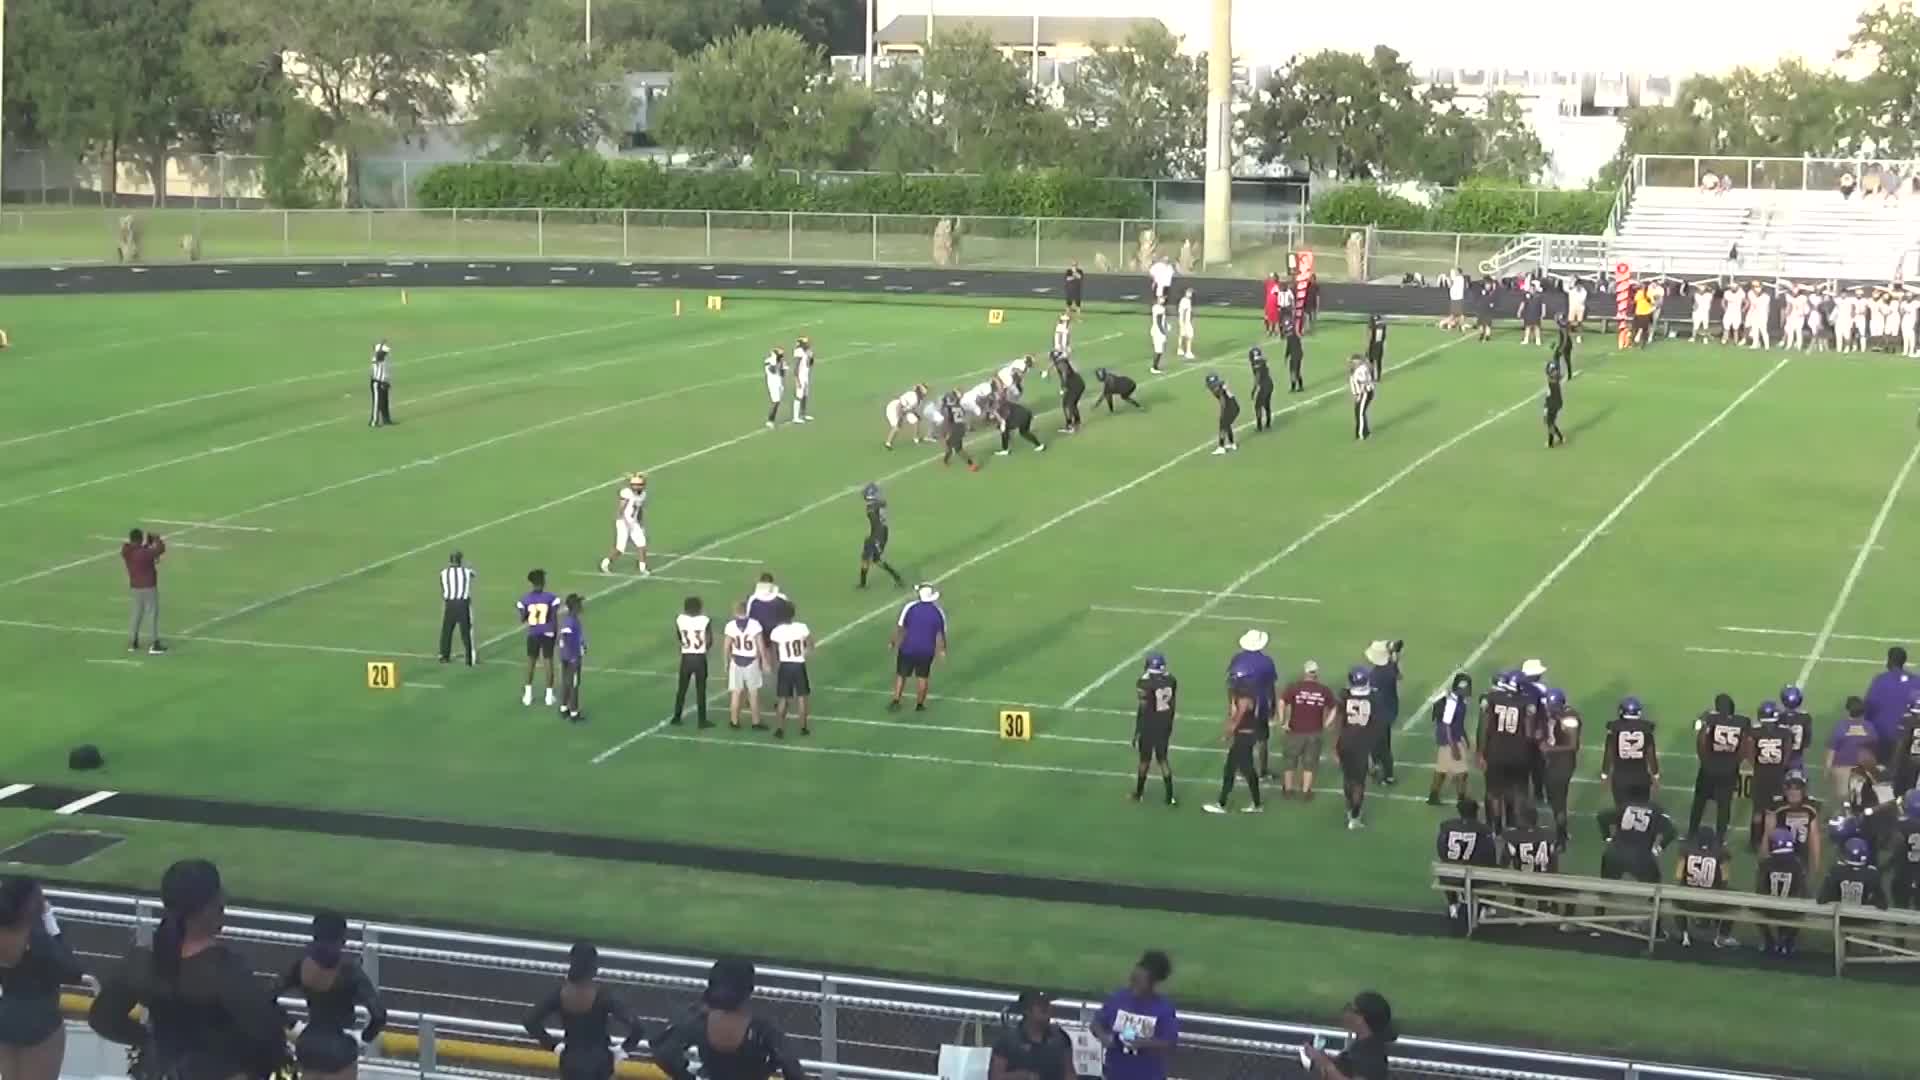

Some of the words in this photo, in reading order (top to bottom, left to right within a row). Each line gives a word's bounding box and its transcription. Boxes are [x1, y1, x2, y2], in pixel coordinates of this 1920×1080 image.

[372, 665, 389, 686] 20
[1005, 714, 1024, 738] 30
[1494, 704, 1519, 734] 70
[1618, 731, 1645, 760] 62
[1713, 724, 1742, 752] 55
[1757, 738, 1782, 764] 35
[1447, 831, 1476, 860] 57
[1519, 841, 1549, 872] 54
[1687, 855, 1717, 888] 50
